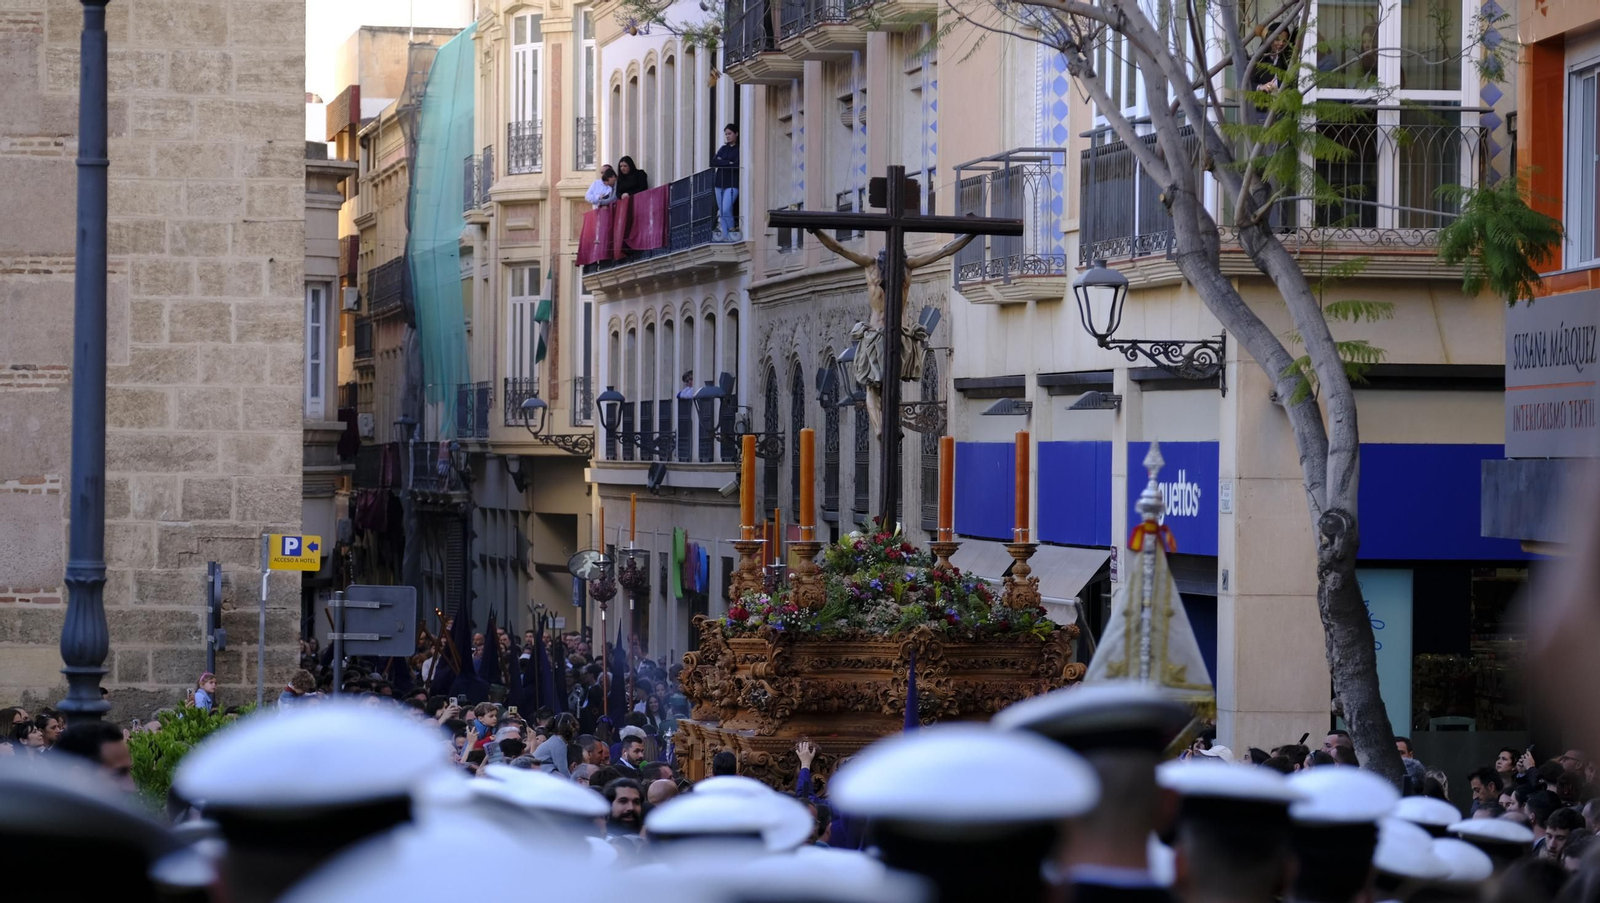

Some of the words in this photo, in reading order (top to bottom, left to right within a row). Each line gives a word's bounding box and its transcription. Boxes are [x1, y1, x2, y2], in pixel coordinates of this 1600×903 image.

[1513, 331, 1548, 370] SUSANA
[1549, 320, 1597, 374] MÁRQUEZ
[1513, 401, 1567, 432] INTERIORISMO
[1569, 398, 1596, 428] TEXTIL
[1158, 469, 1199, 526] guettos
[284, 537, 299, 555] P
